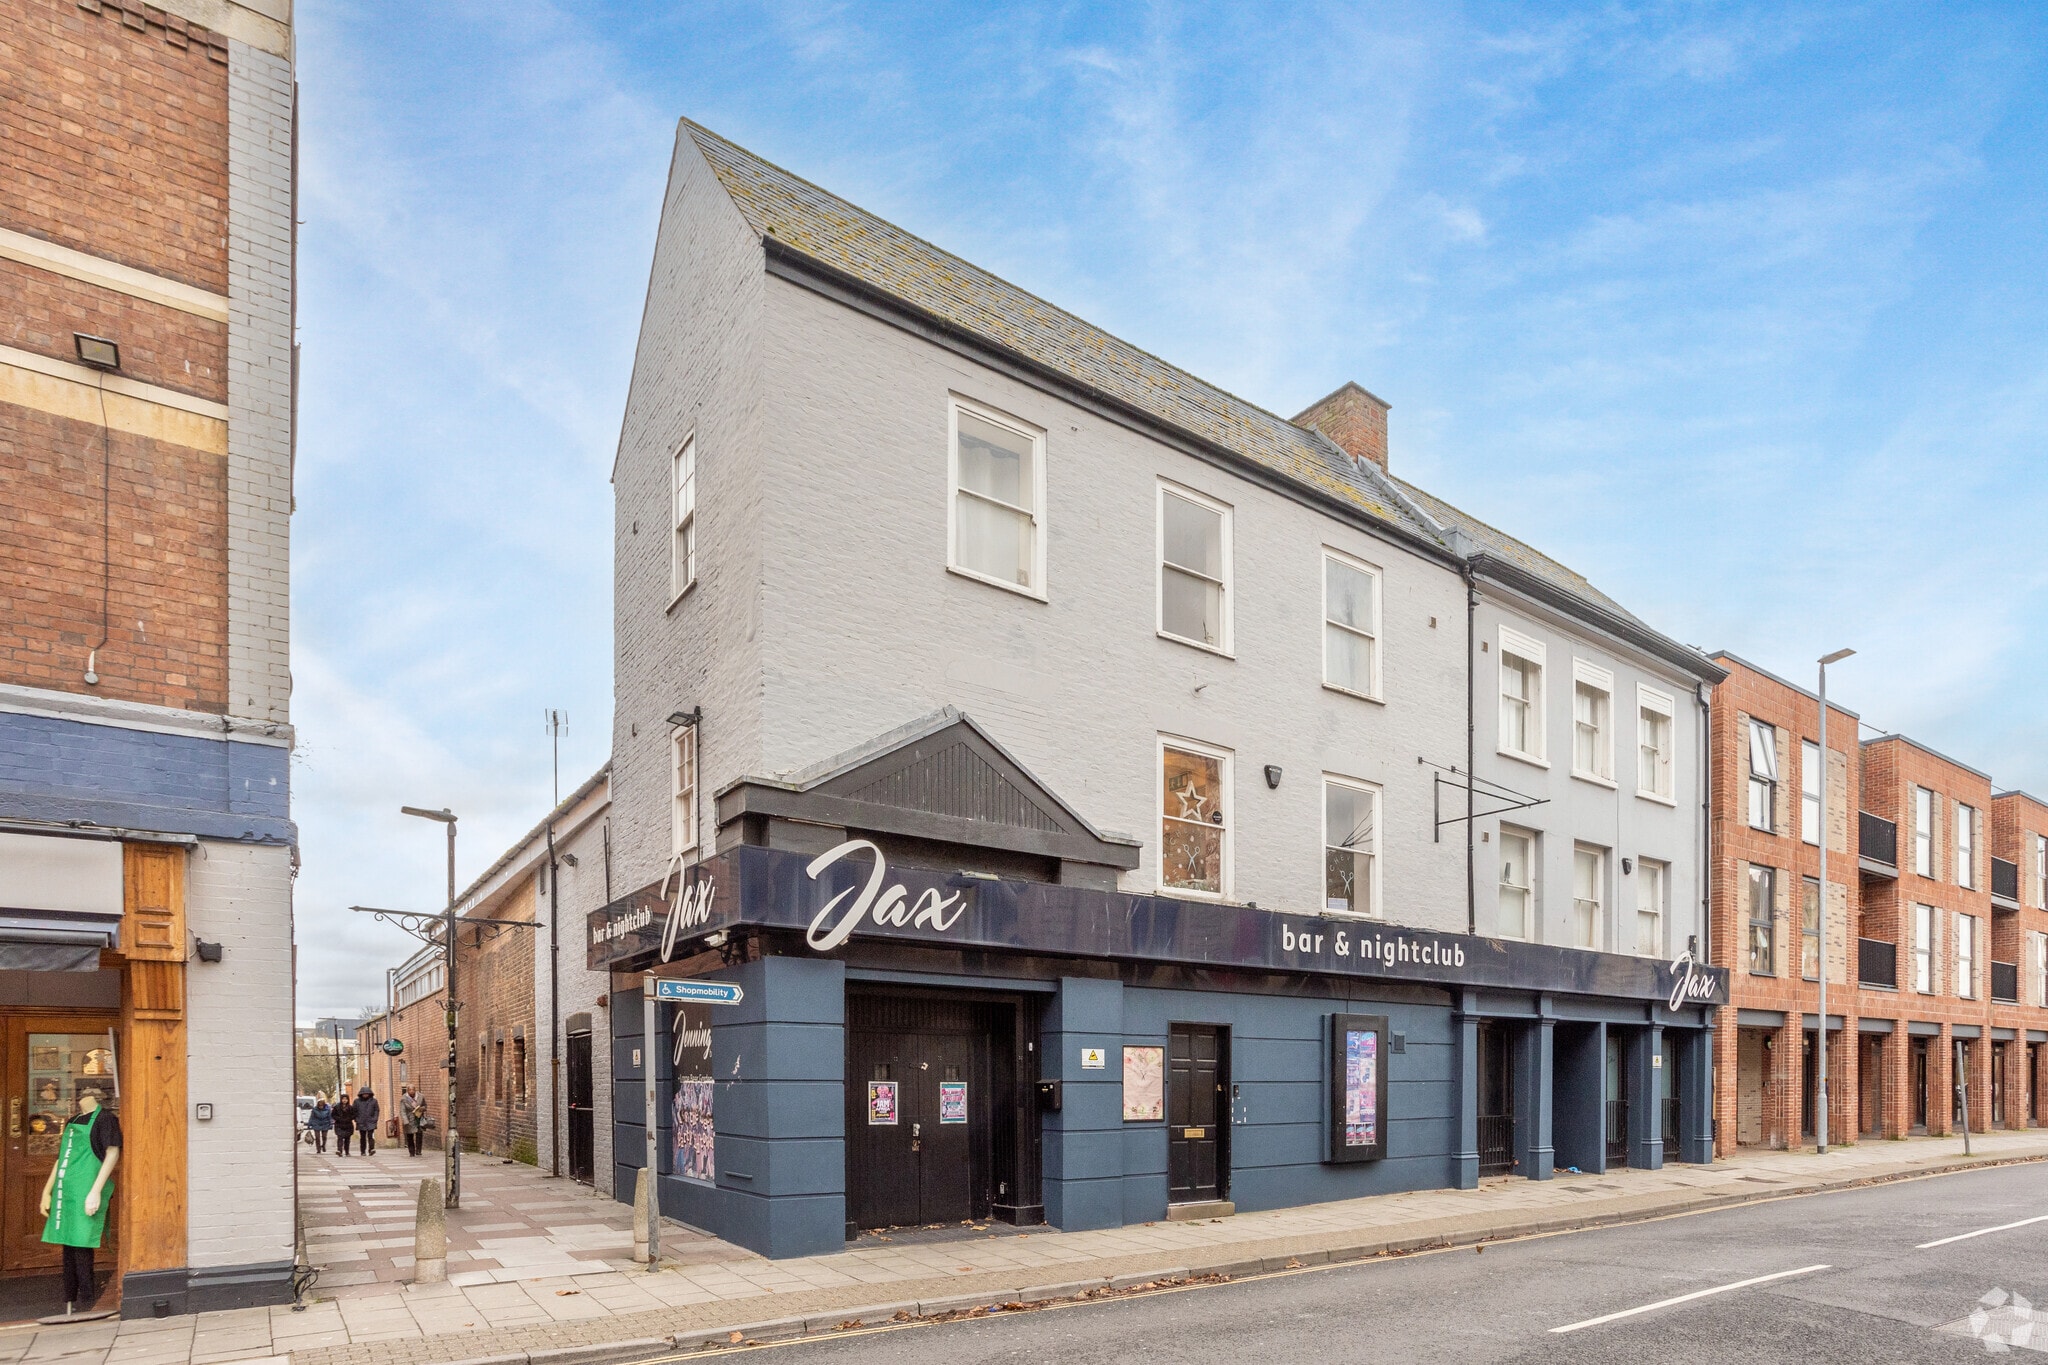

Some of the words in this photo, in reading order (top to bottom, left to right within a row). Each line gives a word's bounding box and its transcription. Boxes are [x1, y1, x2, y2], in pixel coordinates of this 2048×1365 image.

[660, 853, 715, 963] Jax
[806, 839, 967, 951] Jax
[592, 927, 605, 945] bar
[606, 921, 612, 940] &
[613, 905, 651, 940] nightclub
[1282, 923, 1324, 954] bar
[1334, 931, 1350, 957] &
[1360, 934, 1465, 968] nightclub
[676, 986, 729, 998] Shopmobility
[1669, 950, 1716, 1012] Jax
